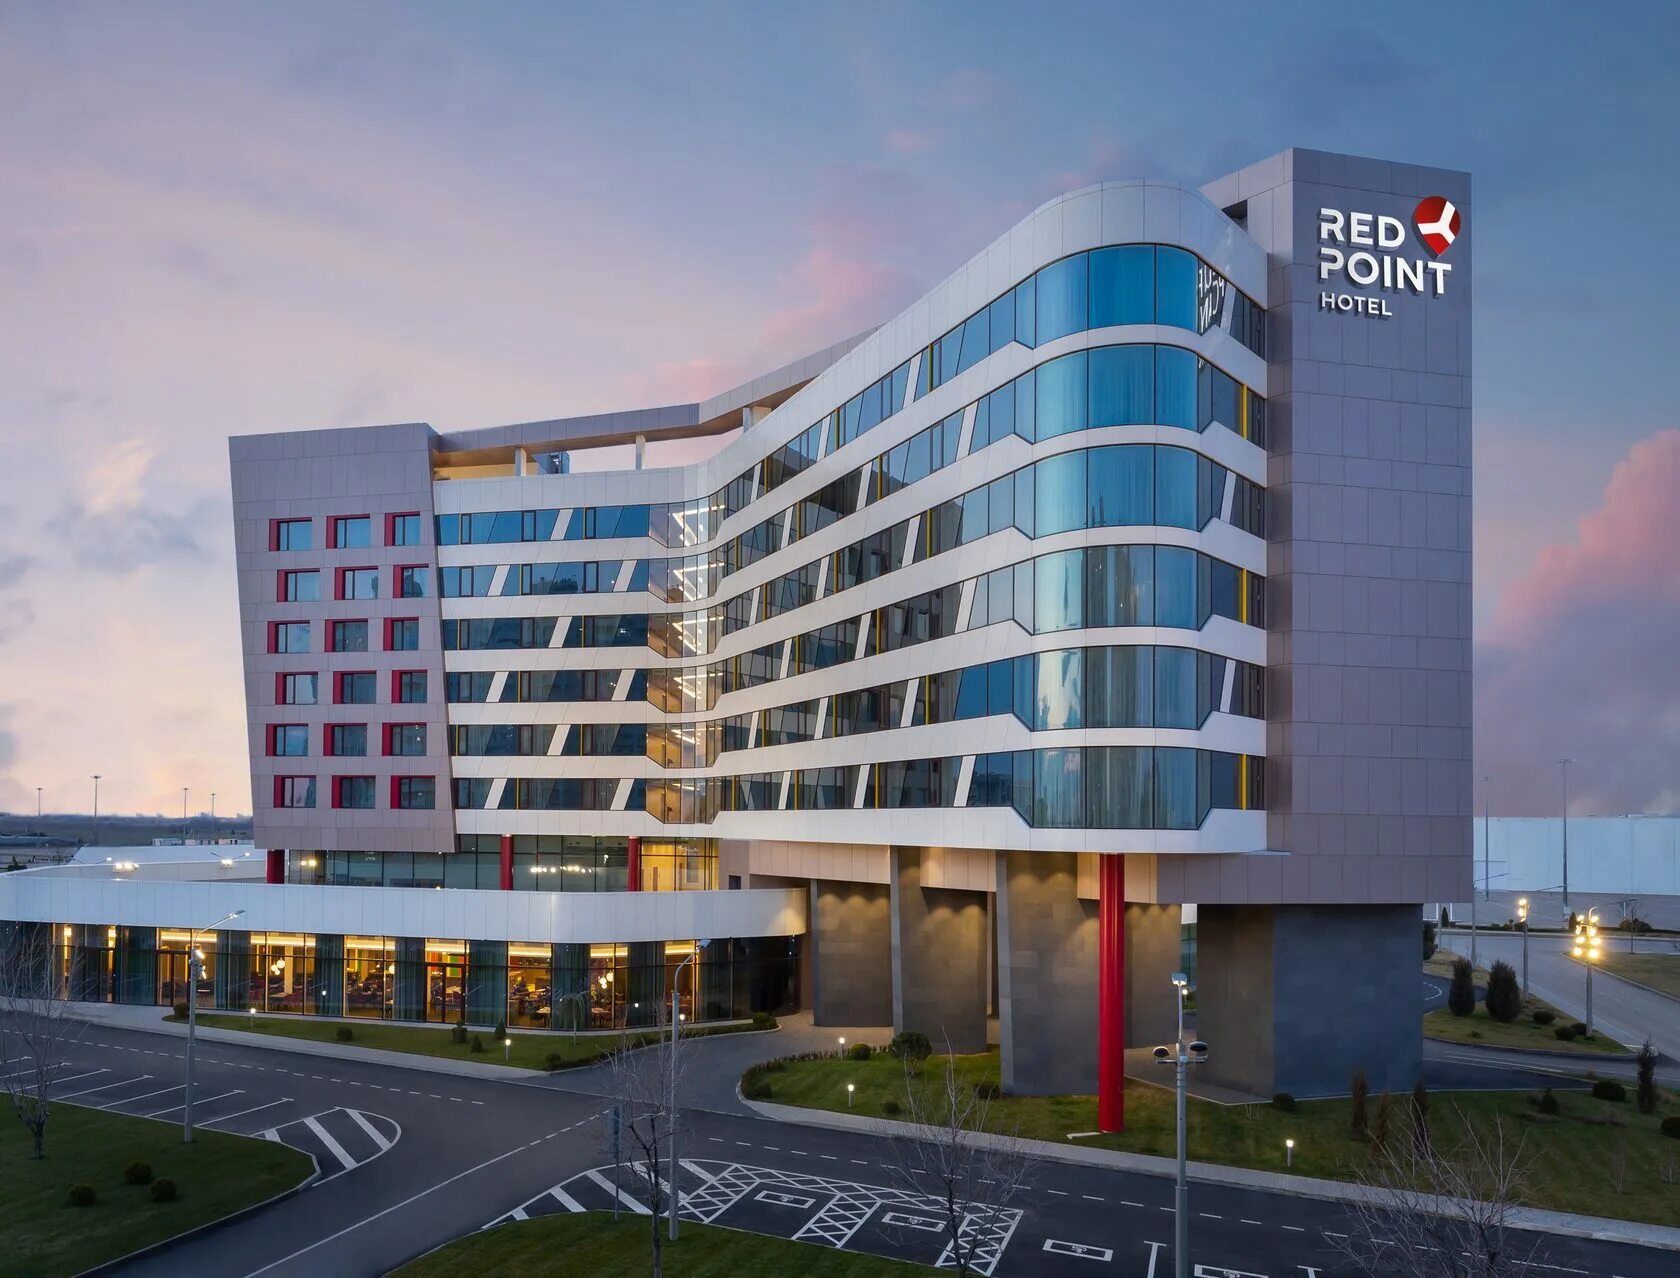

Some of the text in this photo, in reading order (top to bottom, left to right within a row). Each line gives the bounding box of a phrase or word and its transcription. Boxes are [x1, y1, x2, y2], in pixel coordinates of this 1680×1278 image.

[1320, 207, 1405, 248] RED
[1320, 247, 1452, 295] POINT
[1320, 292, 1393, 317] HOTEL
